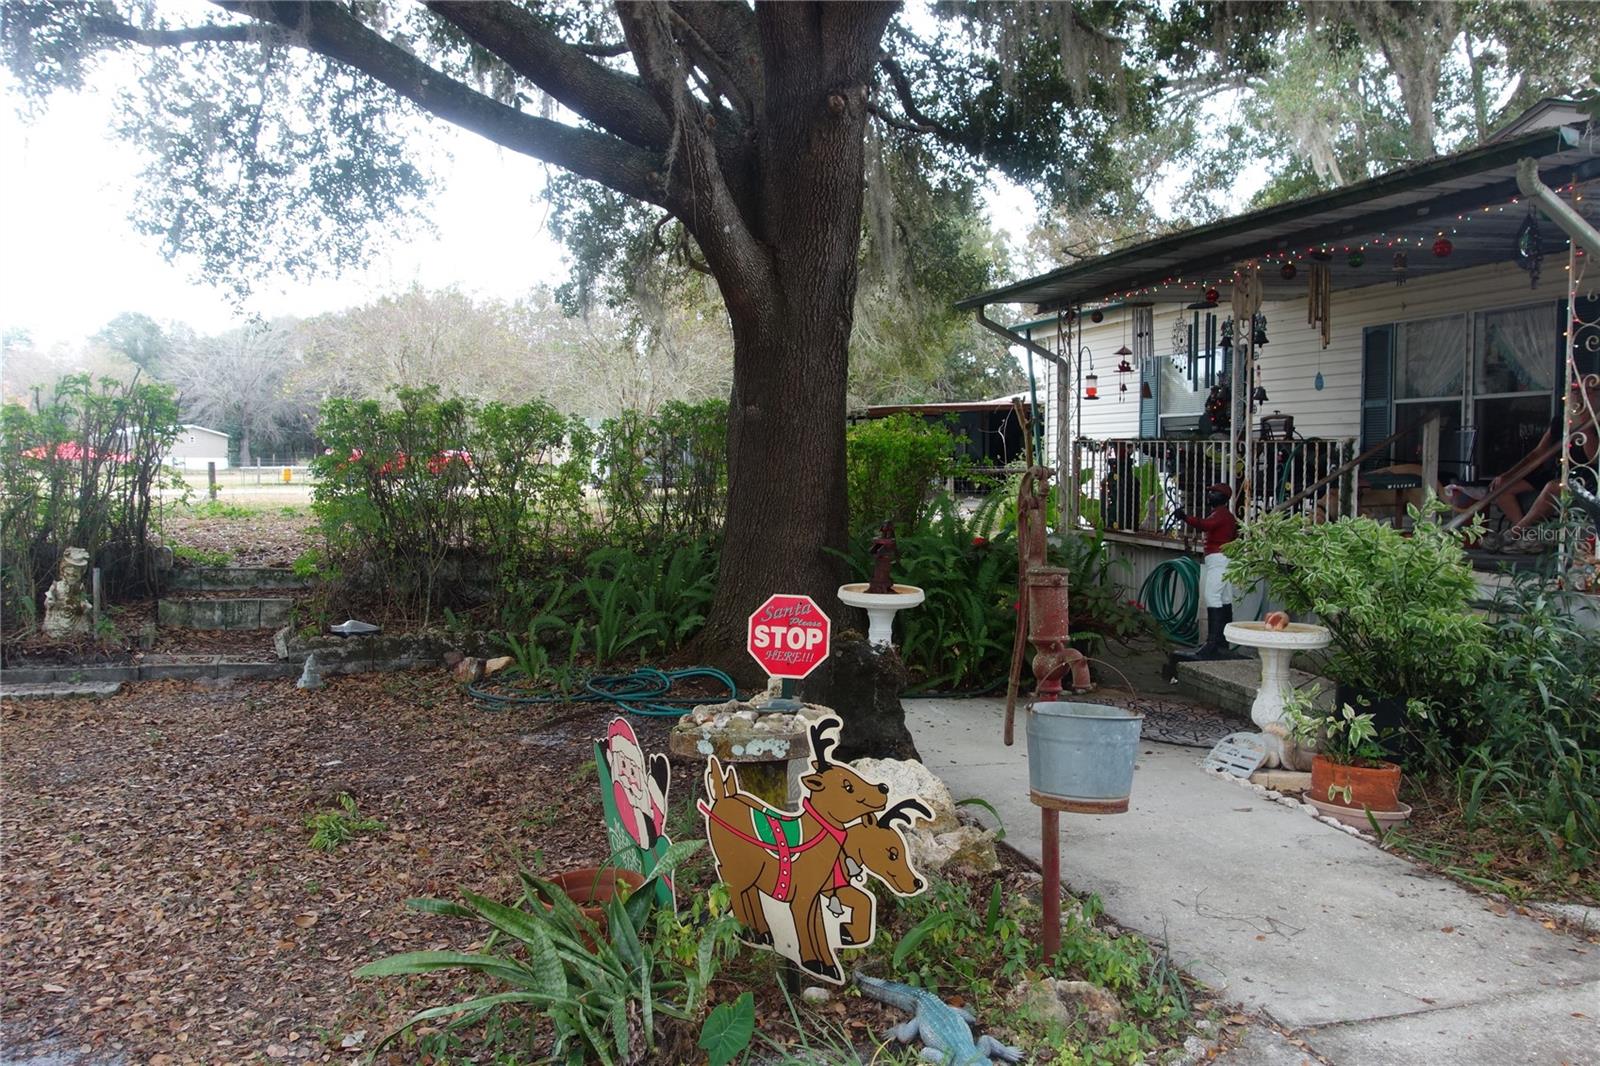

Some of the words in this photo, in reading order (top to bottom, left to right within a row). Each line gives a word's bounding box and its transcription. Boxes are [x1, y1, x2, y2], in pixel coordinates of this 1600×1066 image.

[760, 603, 812, 622] Santa
[789, 617, 822, 627] Please
[754, 625, 823, 650] STOP
